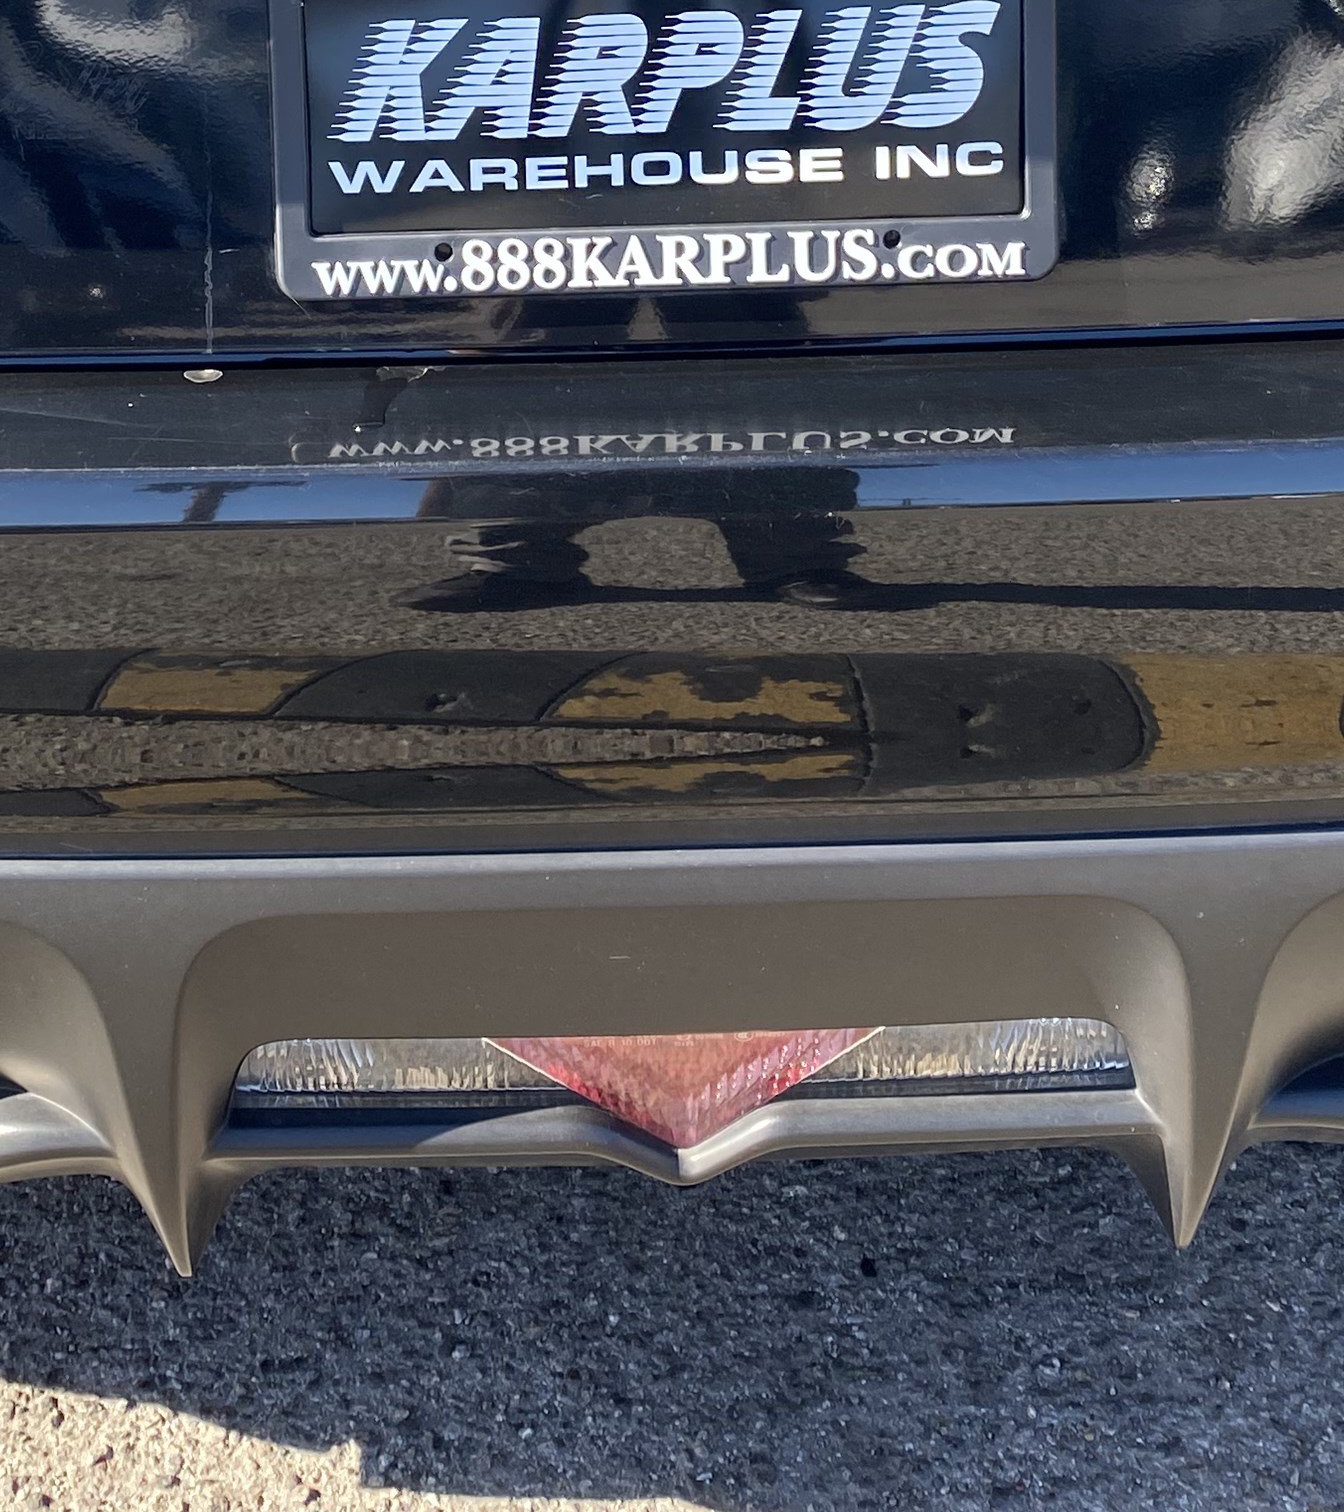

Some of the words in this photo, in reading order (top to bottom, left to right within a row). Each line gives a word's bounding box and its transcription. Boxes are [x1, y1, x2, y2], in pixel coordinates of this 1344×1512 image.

[326, 0, 1003, 143] KARPLUS
[327, 147, 845, 195] WAREHOUSE
[874, 140, 1006, 180] INC
